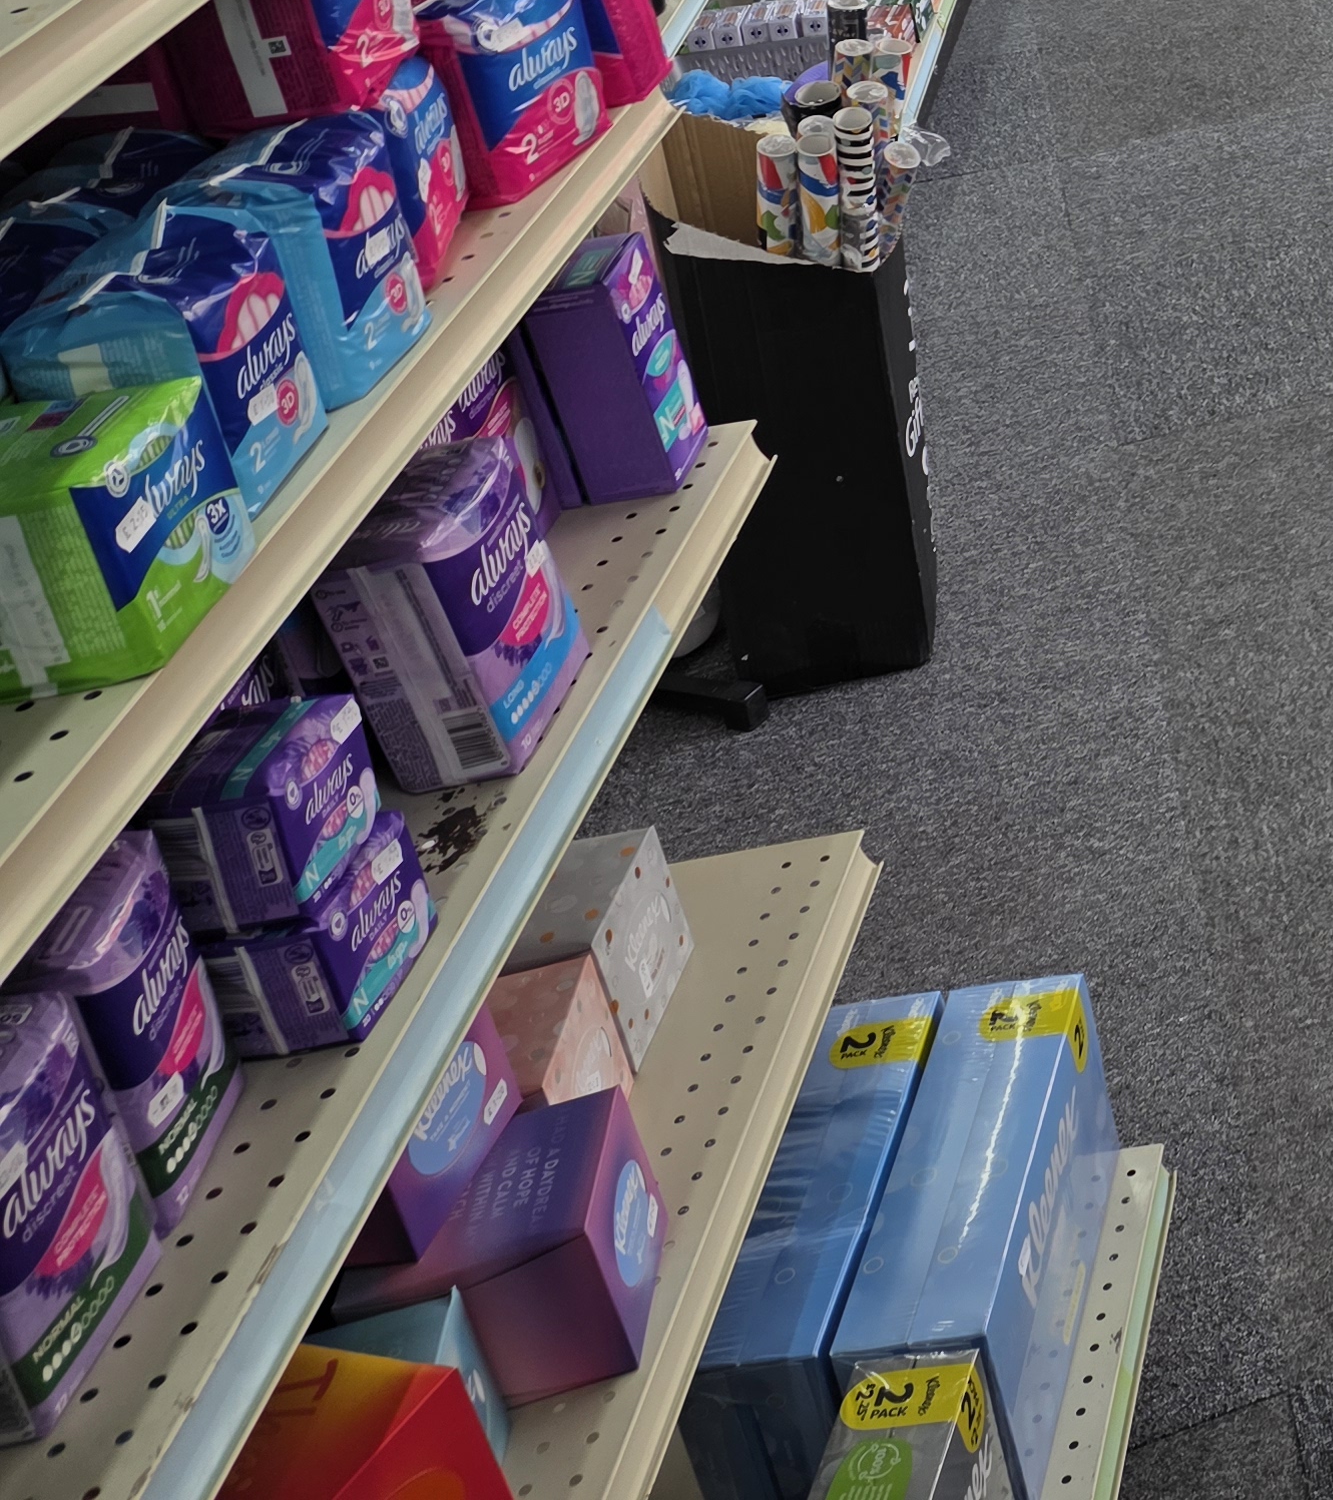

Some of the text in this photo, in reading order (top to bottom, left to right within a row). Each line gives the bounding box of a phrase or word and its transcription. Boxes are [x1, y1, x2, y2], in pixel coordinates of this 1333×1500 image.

[356, 34, 375, 68] 2
[508, 27, 578, 92] always
[413, 92, 448, 153] always
[552, 91, 571, 110] 3D
[521, 132, 541, 166] 2
[428, 197, 443, 229] 2
[364, 321, 377, 351] 2
[631, 292, 667, 357] always
[236, 311, 297, 400] always
[458, 350, 506, 414] always
[144, 439, 206, 519] lways
[249, 440, 267, 474] 2
[470, 501, 533, 606] always
[485, 559, 526, 614] discreet
[502, 678, 526, 710] LONG
[519, 734, 533, 751] 10
[304, 751, 354, 826] always
[321, 793, 340, 819] DAILY
[305, 863, 319, 885] N
[350, 870, 402, 953] always
[368, 914, 390, 943] DAILY
[624, 893, 662, 973] Kleenex
[130, 915, 190, 1038] always
[352, 988, 370, 1016] N
[839, 1031, 877, 1054] 2
[840, 1049, 868, 1060] PACK
[989, 1022, 1018, 1033] PACK
[413, 1045, 474, 1141] Kleenex
[157, 1096, 199, 1157] NORMAL
[2, 1087, 96, 1242] always
[516, 1145, 541, 1208] OF HOPE
[20, 1164, 79, 1245] discreet
[615, 1163, 645, 1256] Kleenex
[1019, 1084, 1080, 1309] Kleenex
[30, 1294, 85, 1363] NORMAL
[869, 1405, 909, 1421] PACK
[873, 1381, 915, 1408] 2
[917, 1374, 941, 1417] Kleenex
[960, 1391, 977, 1432] 2
